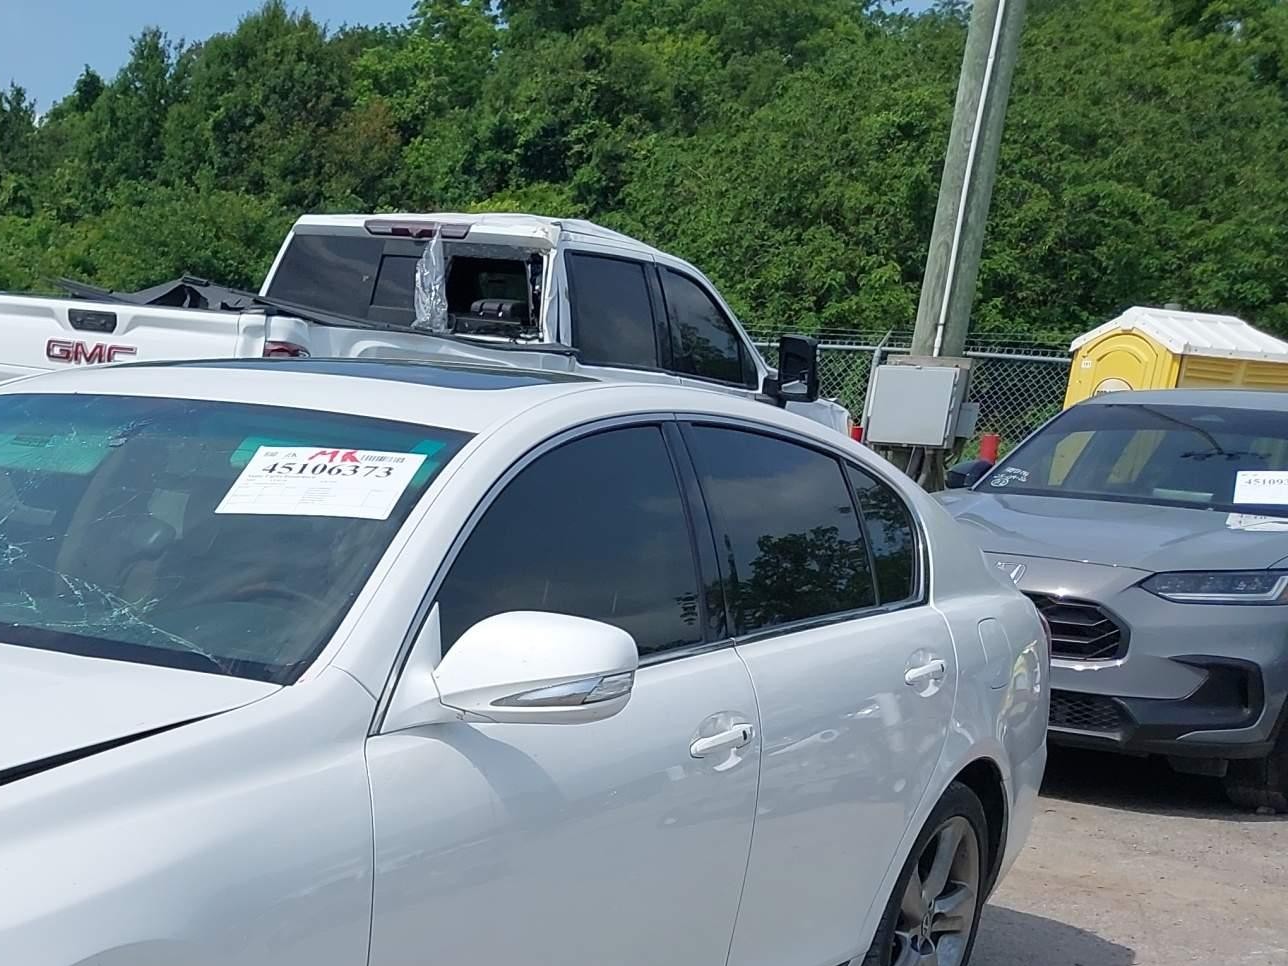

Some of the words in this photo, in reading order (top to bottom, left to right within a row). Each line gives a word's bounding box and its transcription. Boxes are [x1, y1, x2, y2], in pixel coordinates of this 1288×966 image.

[46, 339, 137, 364] GMC
[262, 461, 395, 479] 45106373
[1244, 478, 1288, 486] 45109
